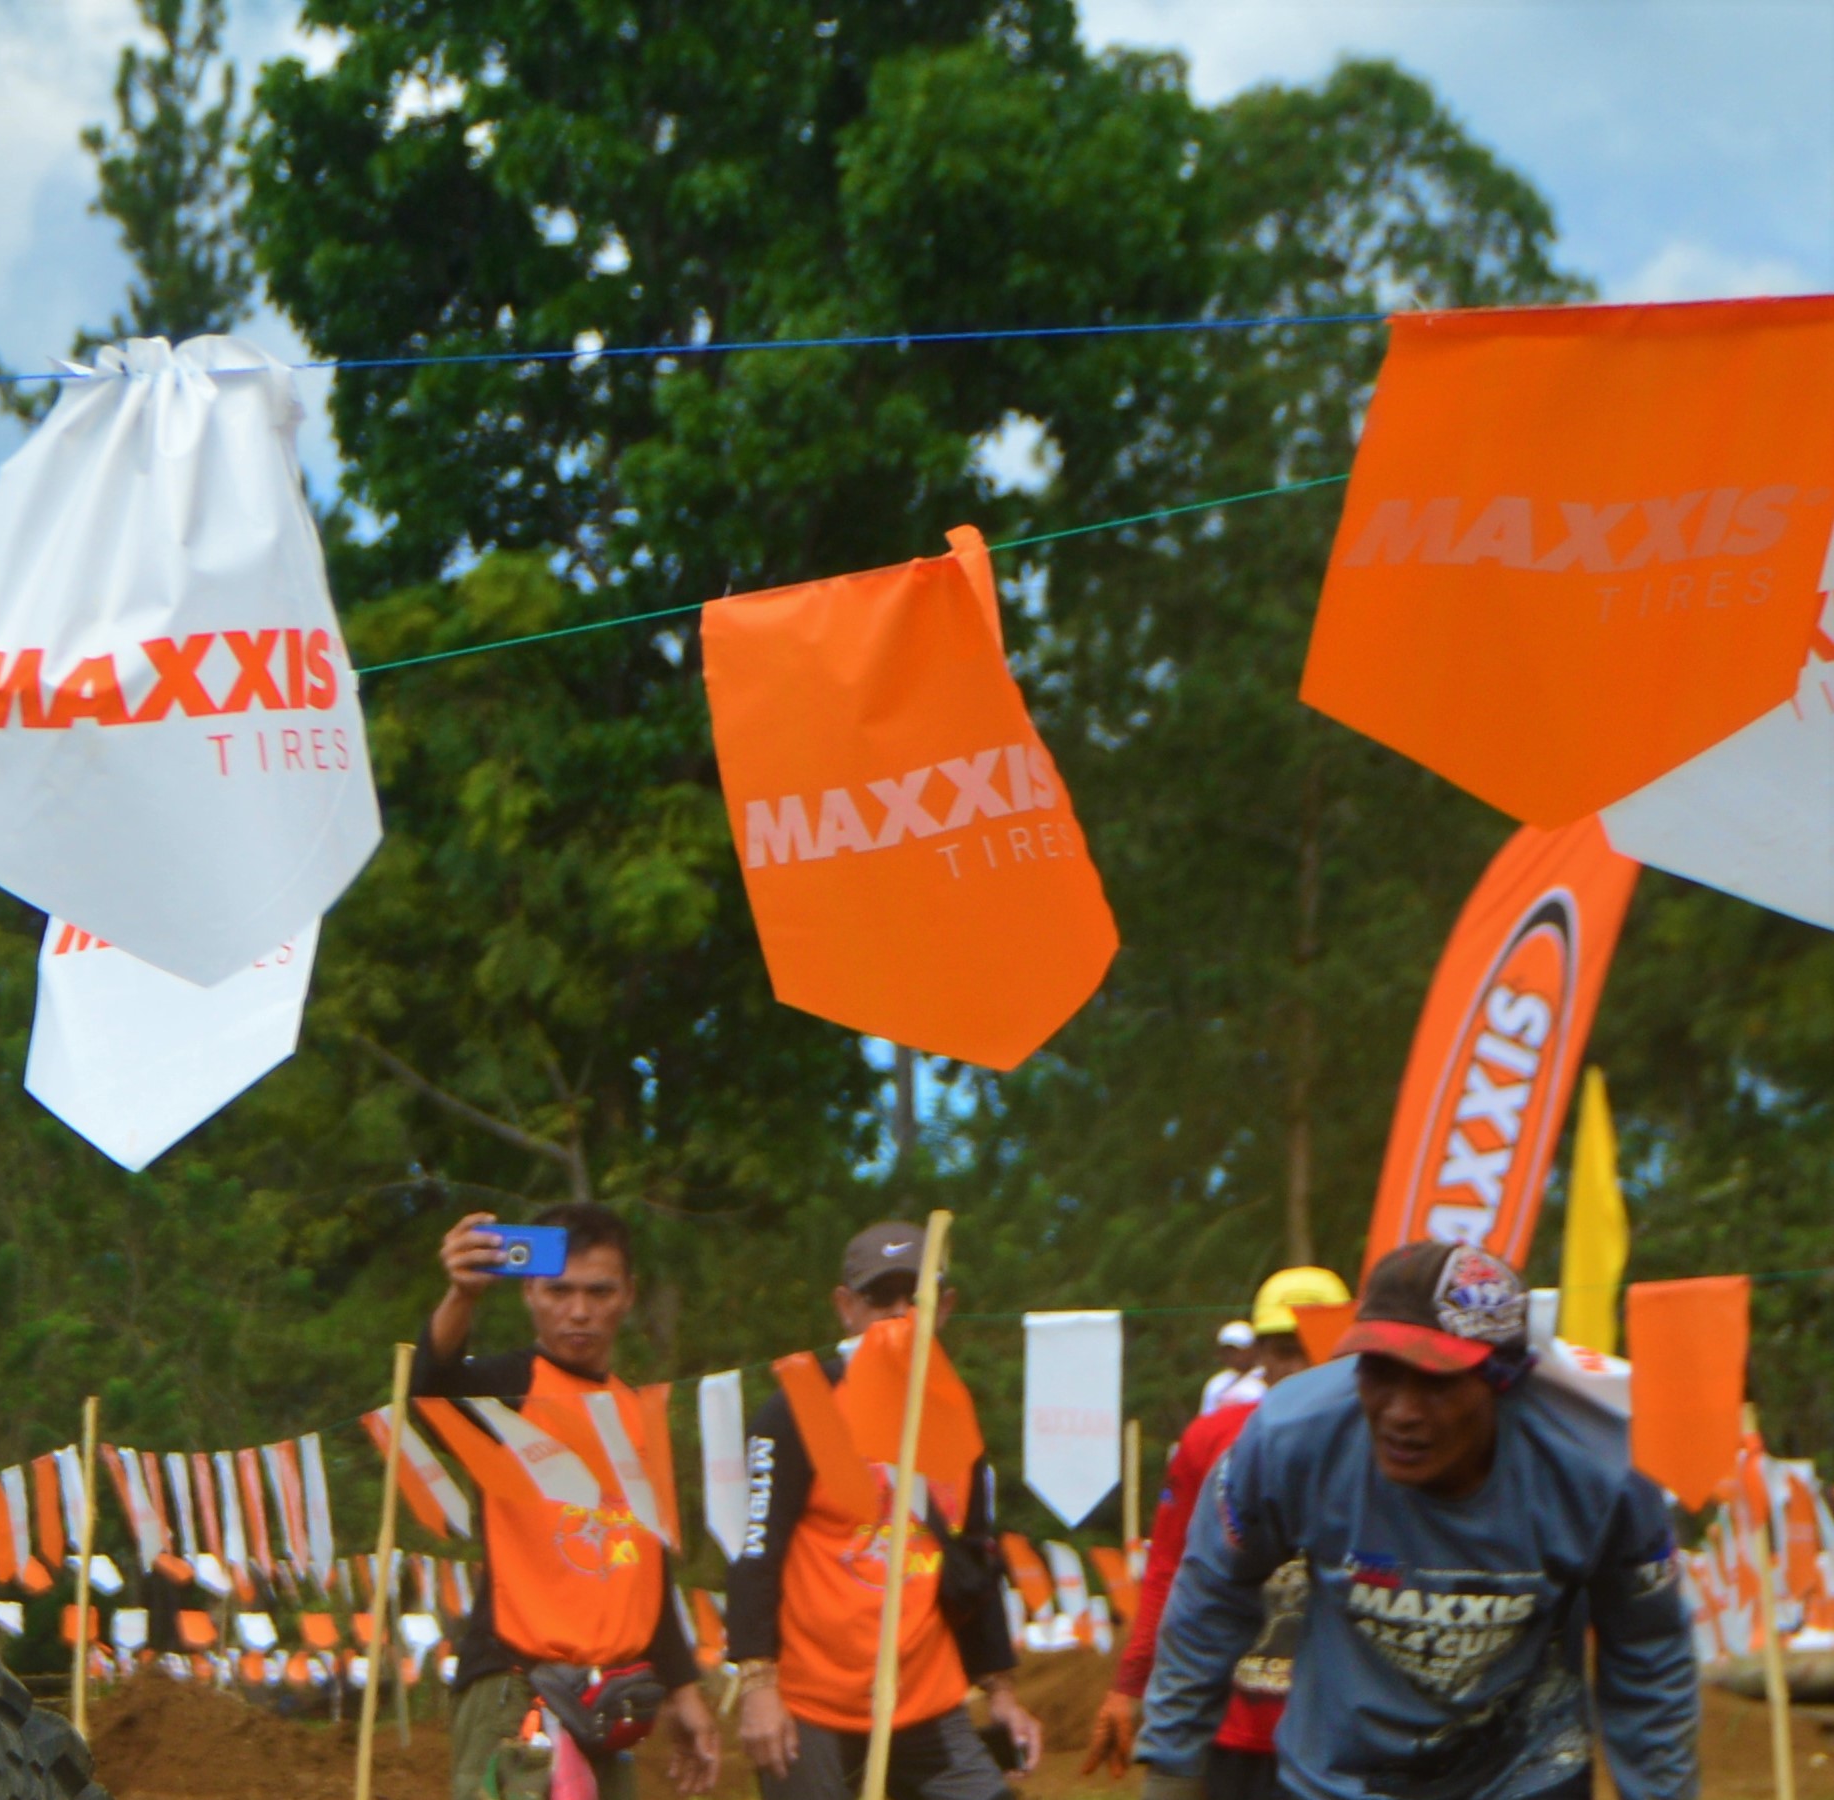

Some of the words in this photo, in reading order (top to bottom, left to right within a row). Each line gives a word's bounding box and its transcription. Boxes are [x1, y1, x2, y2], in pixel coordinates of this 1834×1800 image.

[1342, 484, 1800, 573] MAXXIS
[1595, 567, 1774, 624] TIRES
[207, 728, 350, 777] TIRES
[744, 743, 1058, 869] MAXXIS
[935, 821, 1075, 880] TIRES
[1348, 1581, 1537, 1627] MAXXIS
